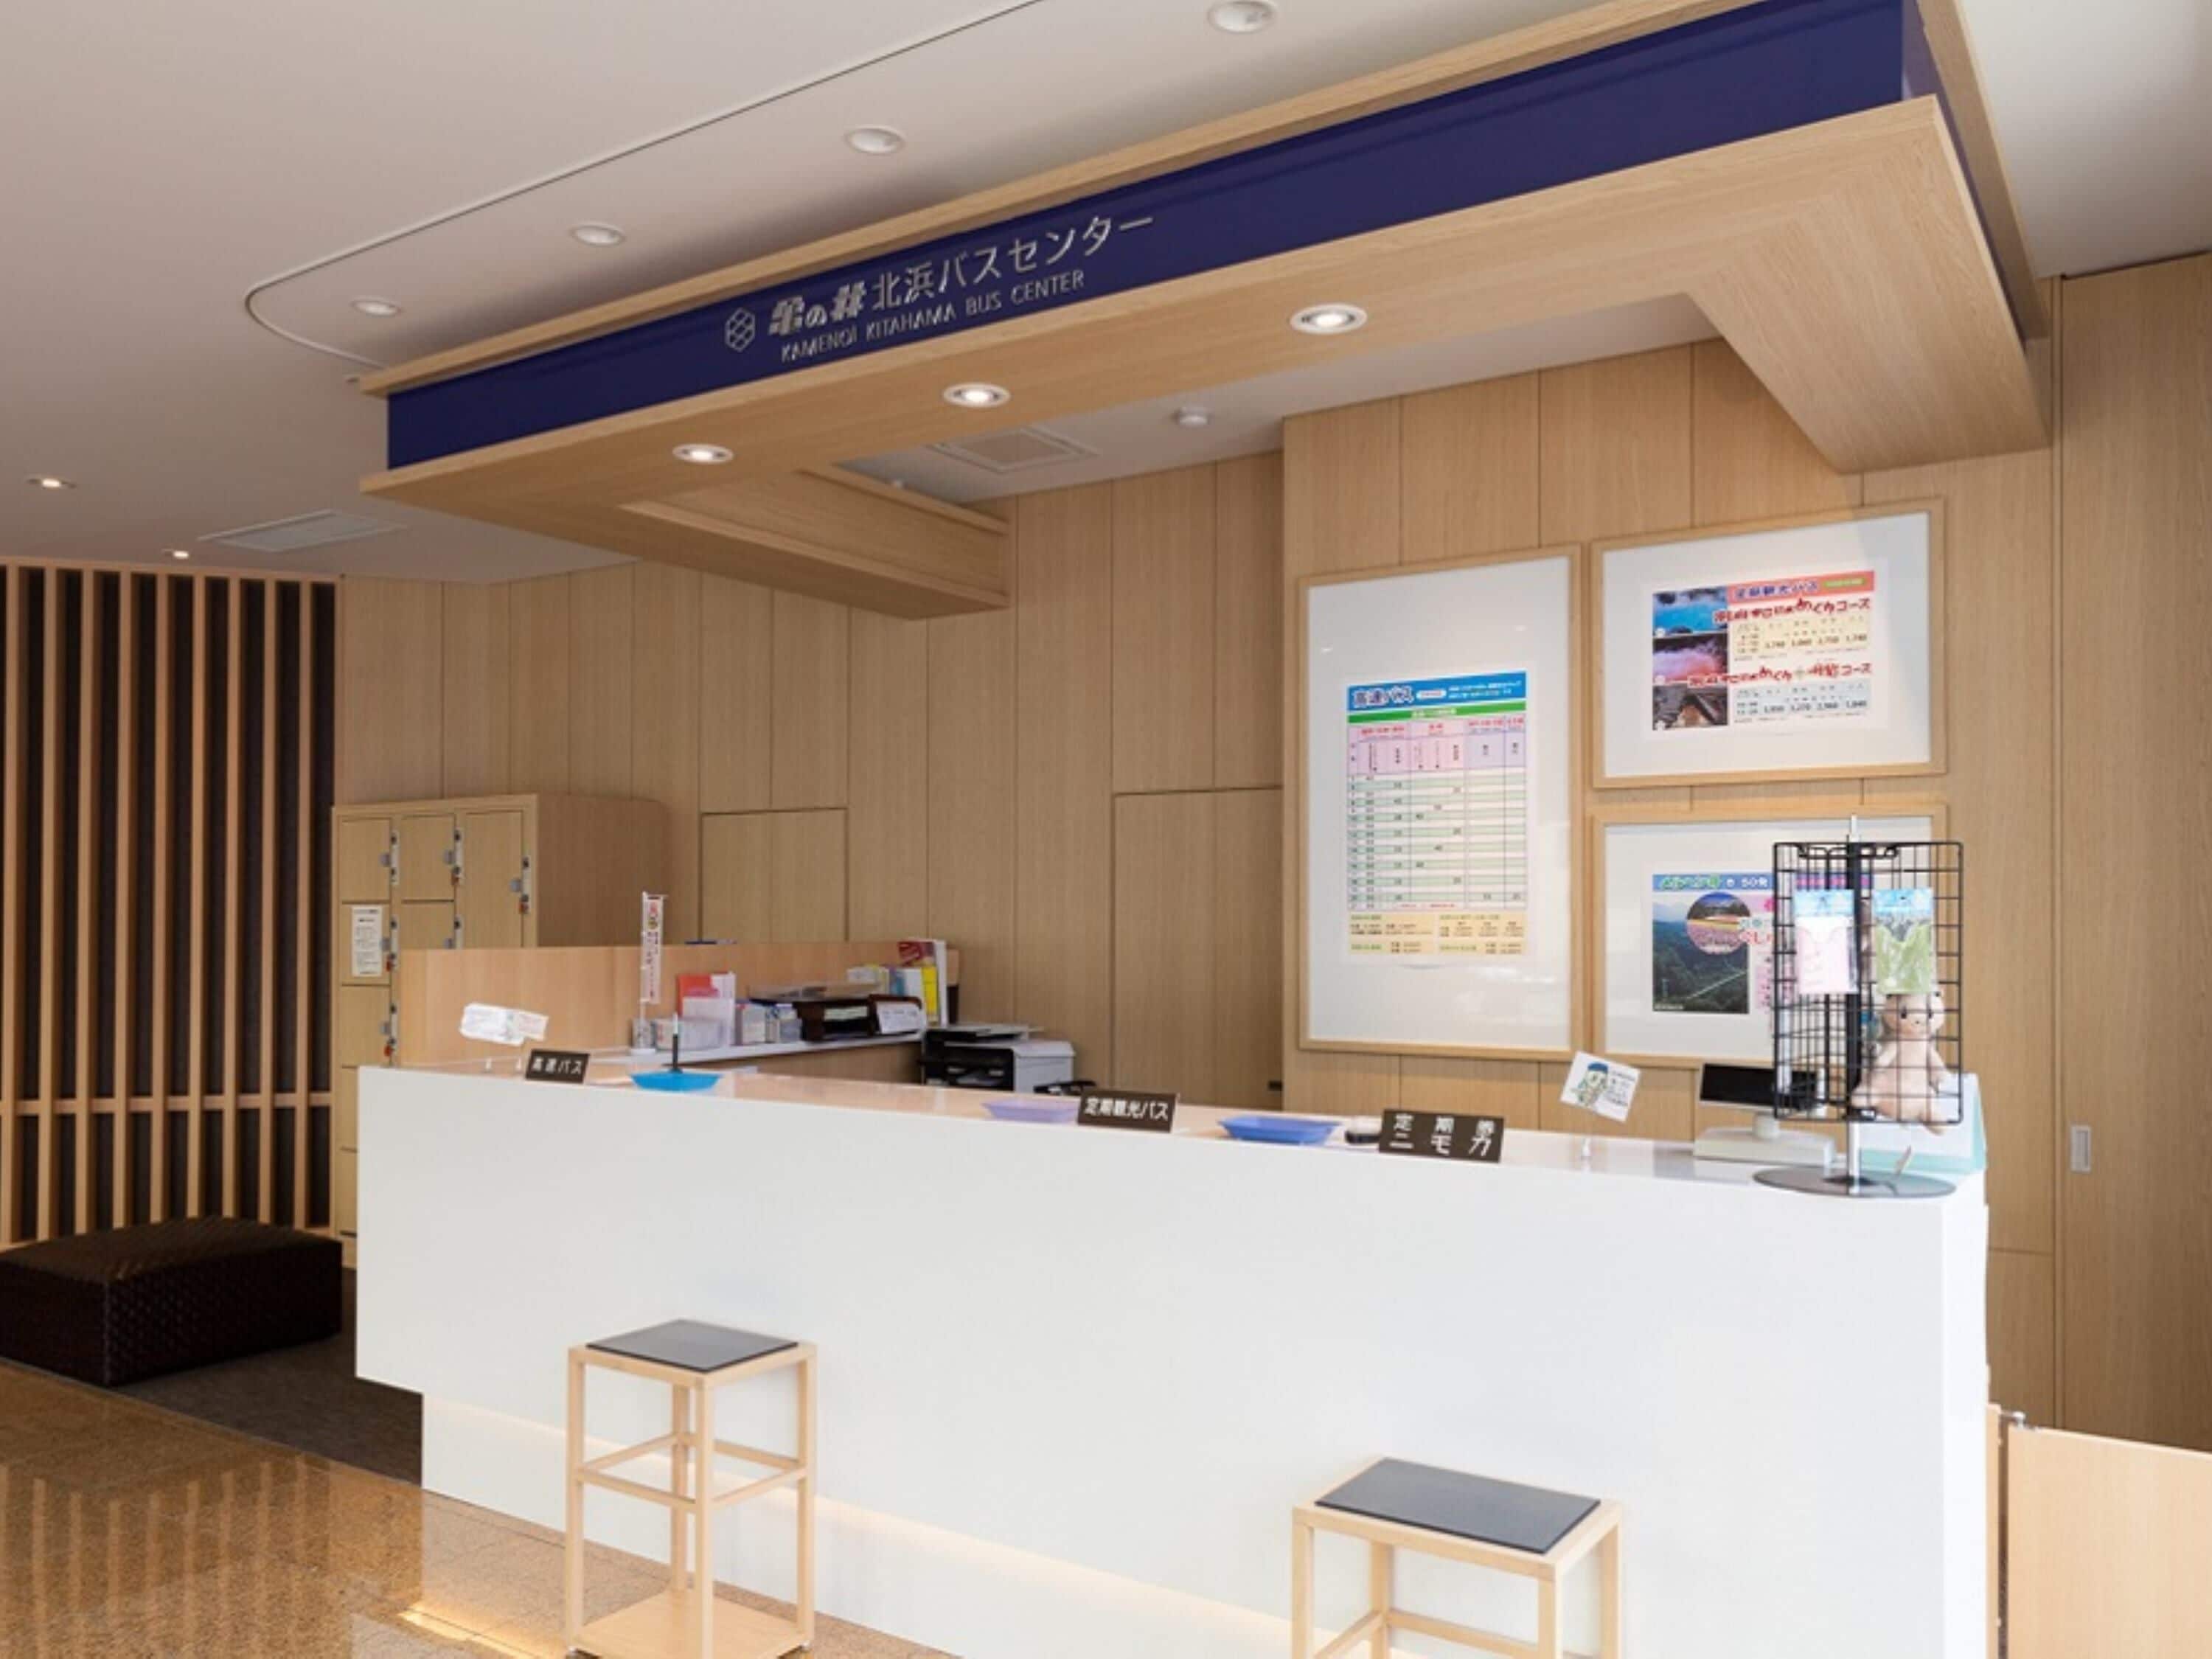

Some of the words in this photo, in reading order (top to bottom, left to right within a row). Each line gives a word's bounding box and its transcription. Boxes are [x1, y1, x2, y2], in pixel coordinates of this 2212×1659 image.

[781, 325, 858, 363] KAMENOI
[866, 302, 956, 341] KITAHAMA
[966, 291, 1001, 316] BUS
[1011, 269, 1085, 306] CENTER
[1083, 1096, 1169, 1121] 定期観光バス
